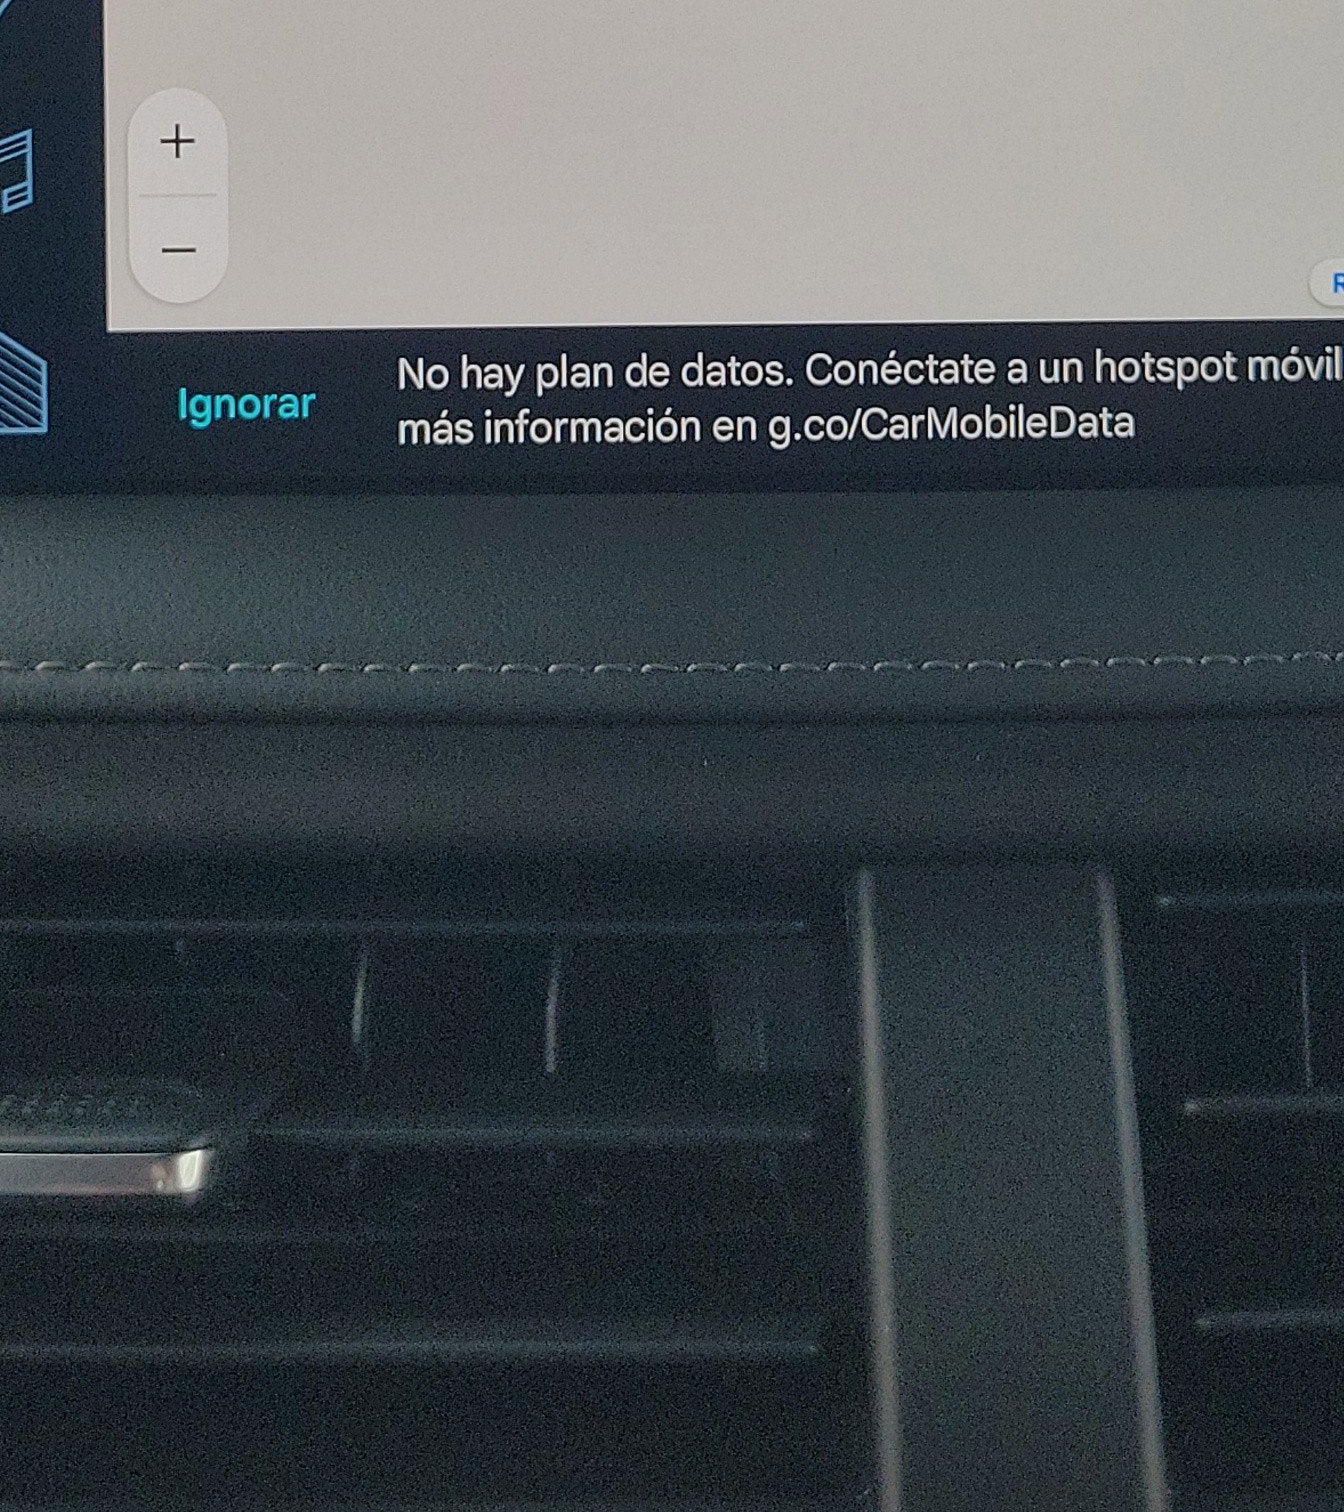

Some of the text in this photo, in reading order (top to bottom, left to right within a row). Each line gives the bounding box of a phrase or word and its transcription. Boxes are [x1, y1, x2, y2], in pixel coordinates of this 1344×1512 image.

[398, 357, 450, 390] No
[461, 354, 526, 398] hay
[536, 353, 614, 398] plan
[624, 352, 671, 388] de
[681, 351, 794, 387] datos.
[805, 349, 996, 386] Conéctate
[1007, 358, 1028, 384] a
[1039, 357, 1084, 384] un
[1095, 347, 1238, 391] hotspot
[1247, 345, 1343, 382] móvil
[179, 387, 317, 430] Ignorar
[398, 403, 1136, 451] más información en g.co/CarMobileData
